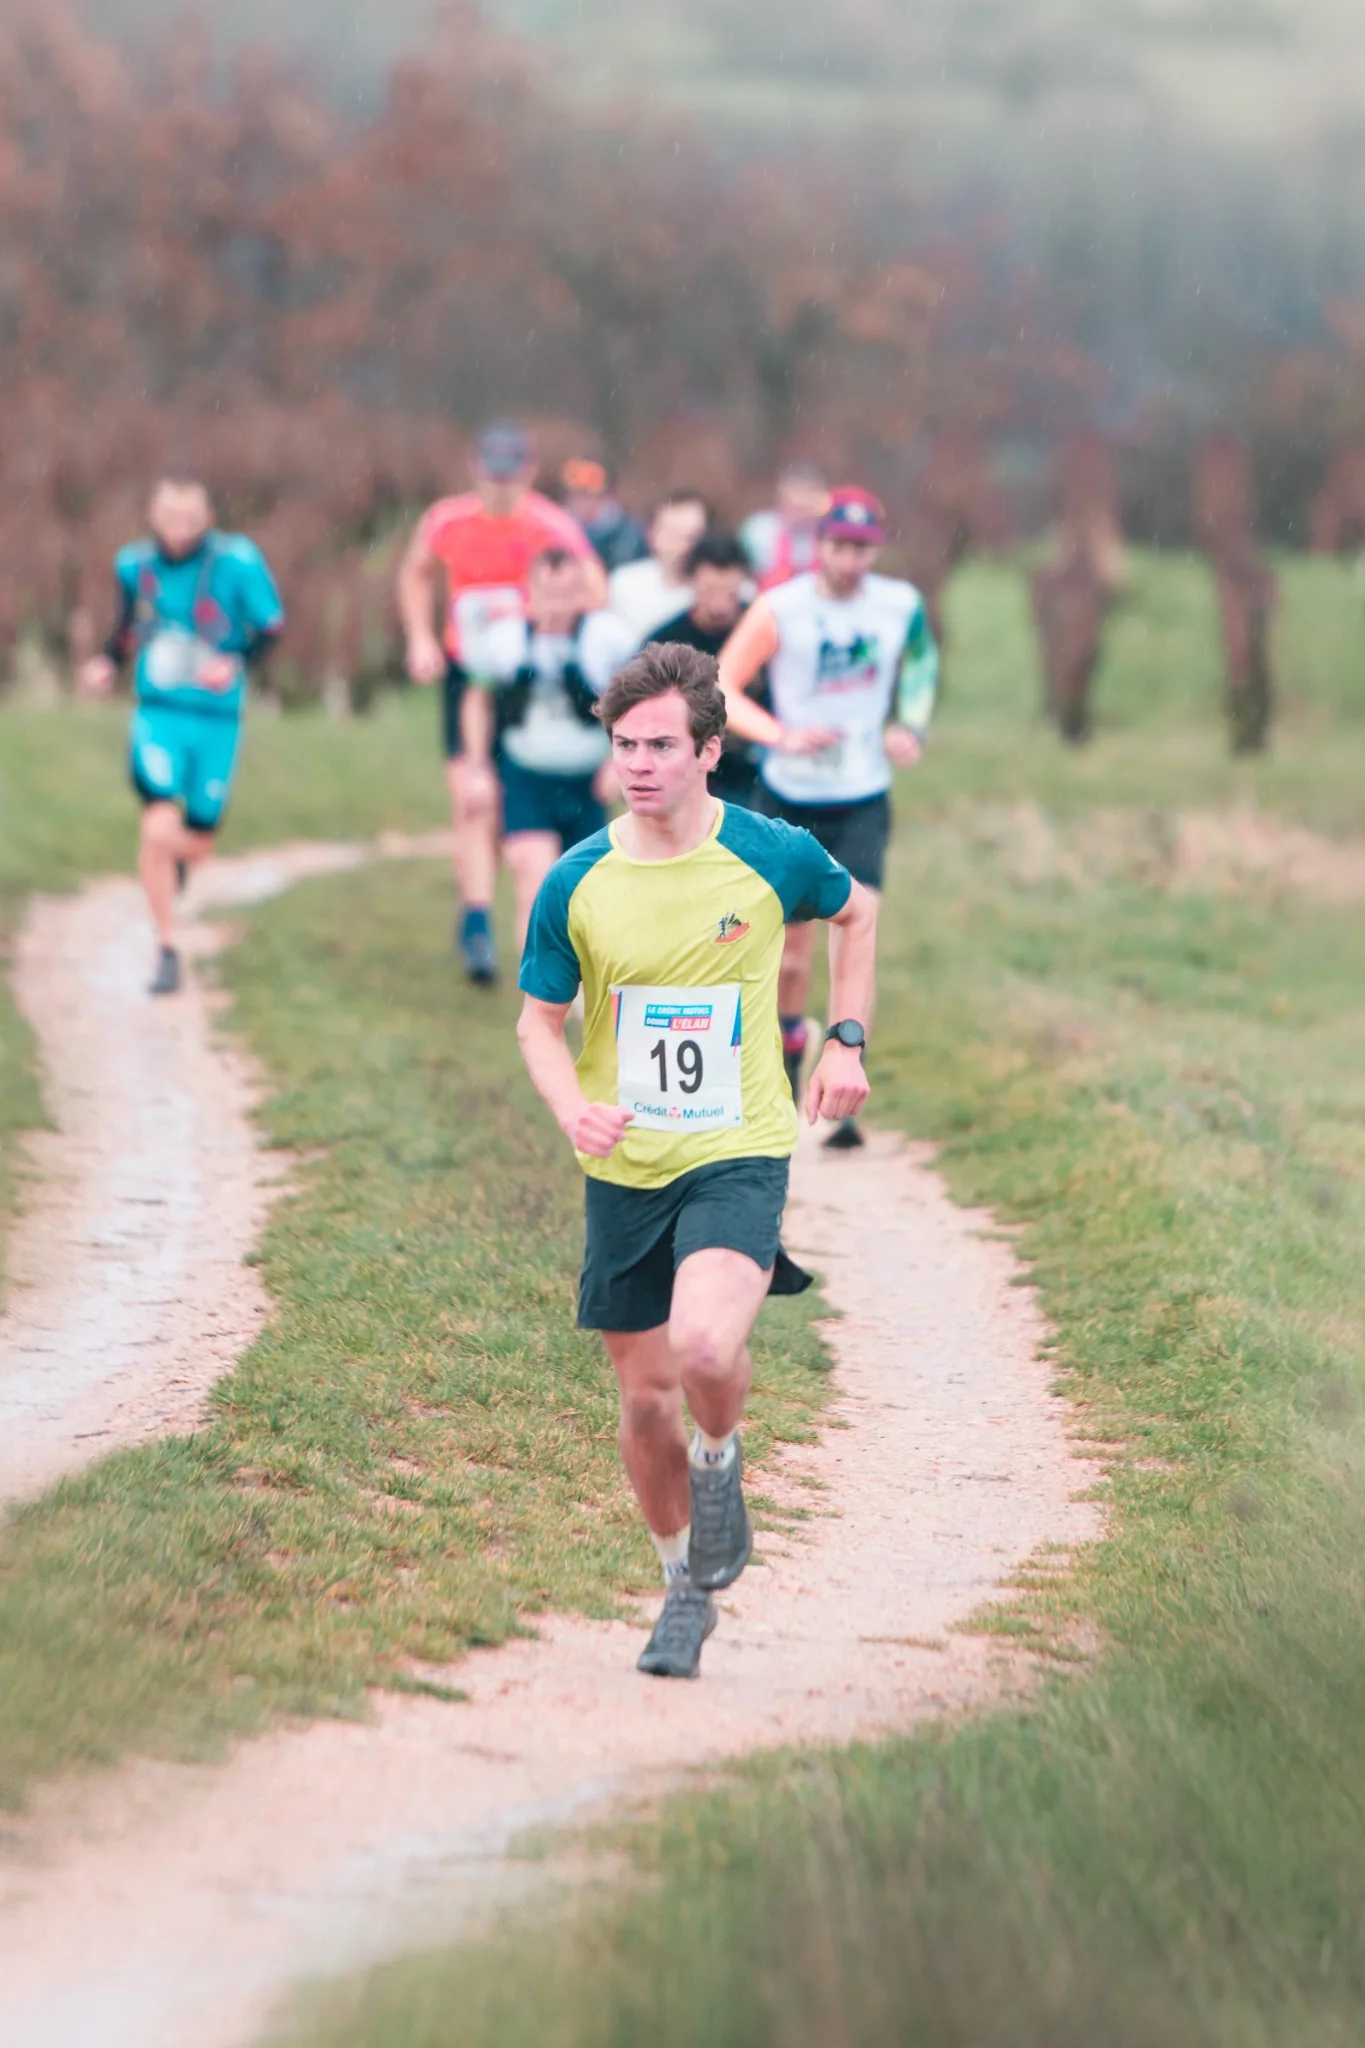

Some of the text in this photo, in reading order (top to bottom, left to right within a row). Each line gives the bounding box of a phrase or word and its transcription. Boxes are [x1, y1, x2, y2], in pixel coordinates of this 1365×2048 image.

[651, 1039, 703, 1094] 19
[634, 1102, 724, 1119] Crédit Mutuel
